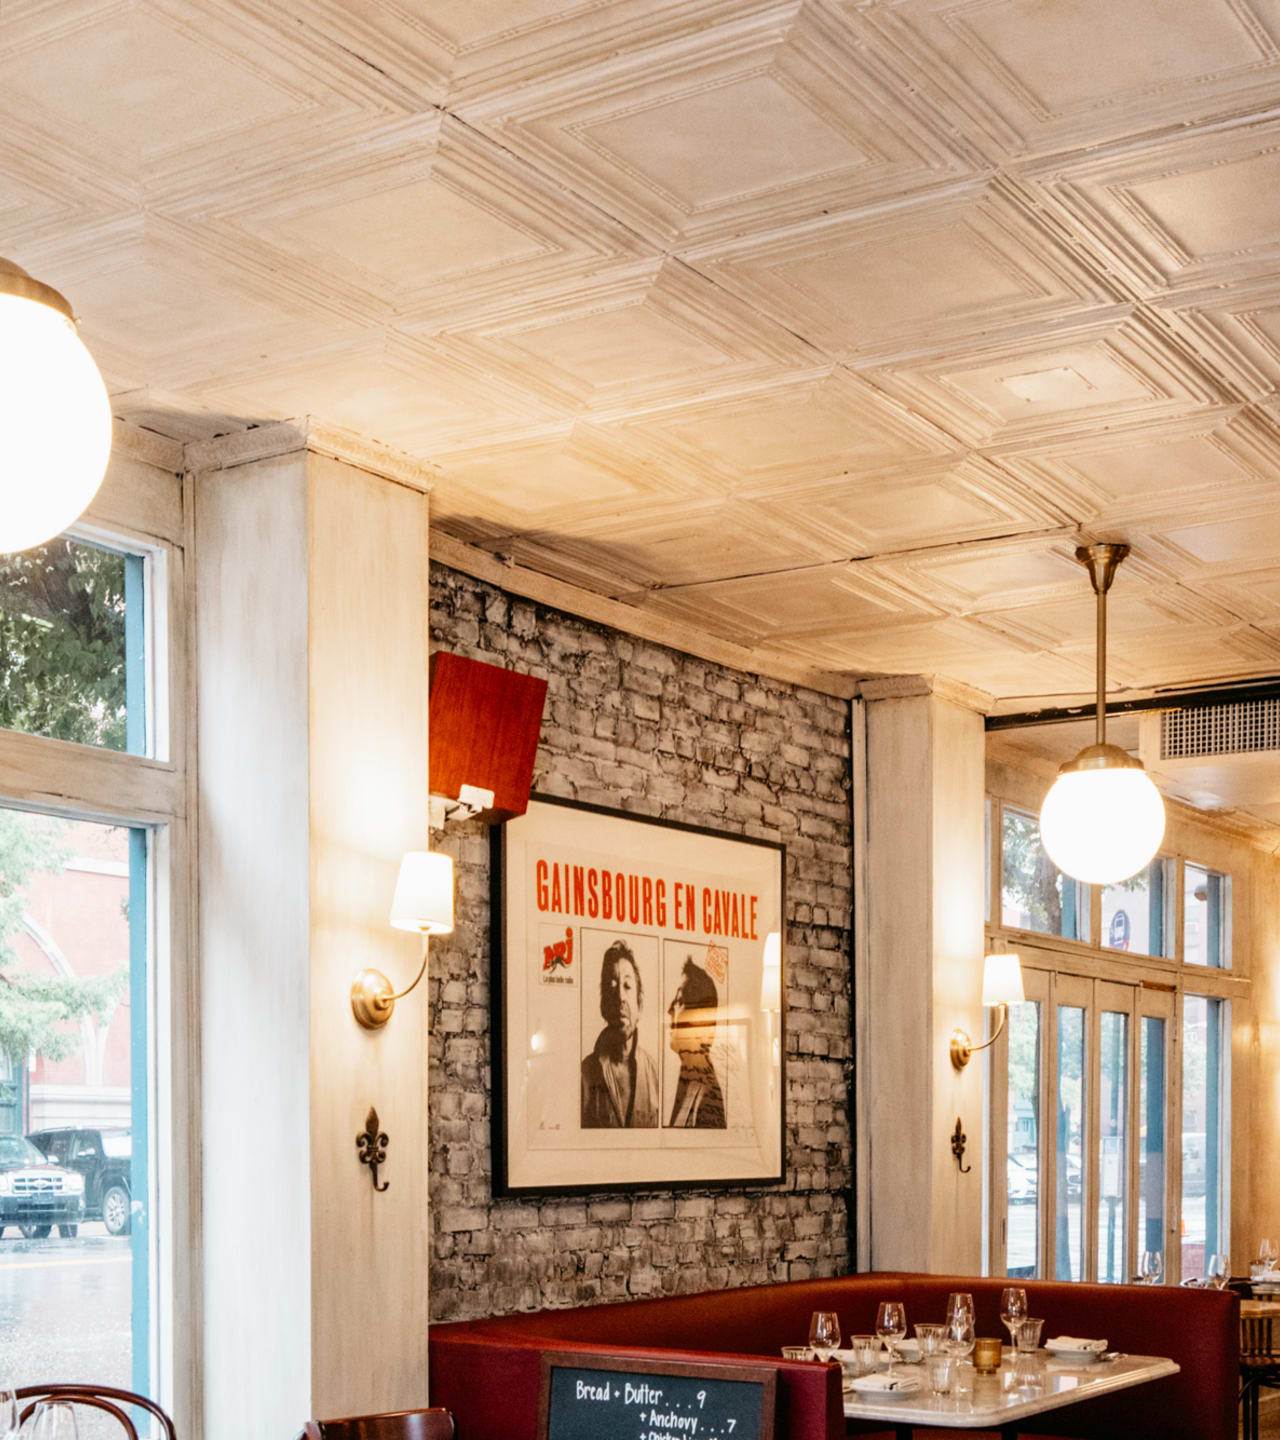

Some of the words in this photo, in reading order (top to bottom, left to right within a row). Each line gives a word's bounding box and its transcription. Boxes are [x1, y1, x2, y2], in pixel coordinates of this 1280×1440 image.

[536, 859, 667, 927] GAINSBOURG
[674, 881, 696, 931] EN
[702, 887, 759, 941] CAVALE
[576, 1380, 610, 1401] Bread
[624, 1383, 663, 1405] Butter
[697, 1390, 706, 1409] 9
[649, 1409, 698, 1434] Anchovy
[727, 1418, 737, 1433] 7
